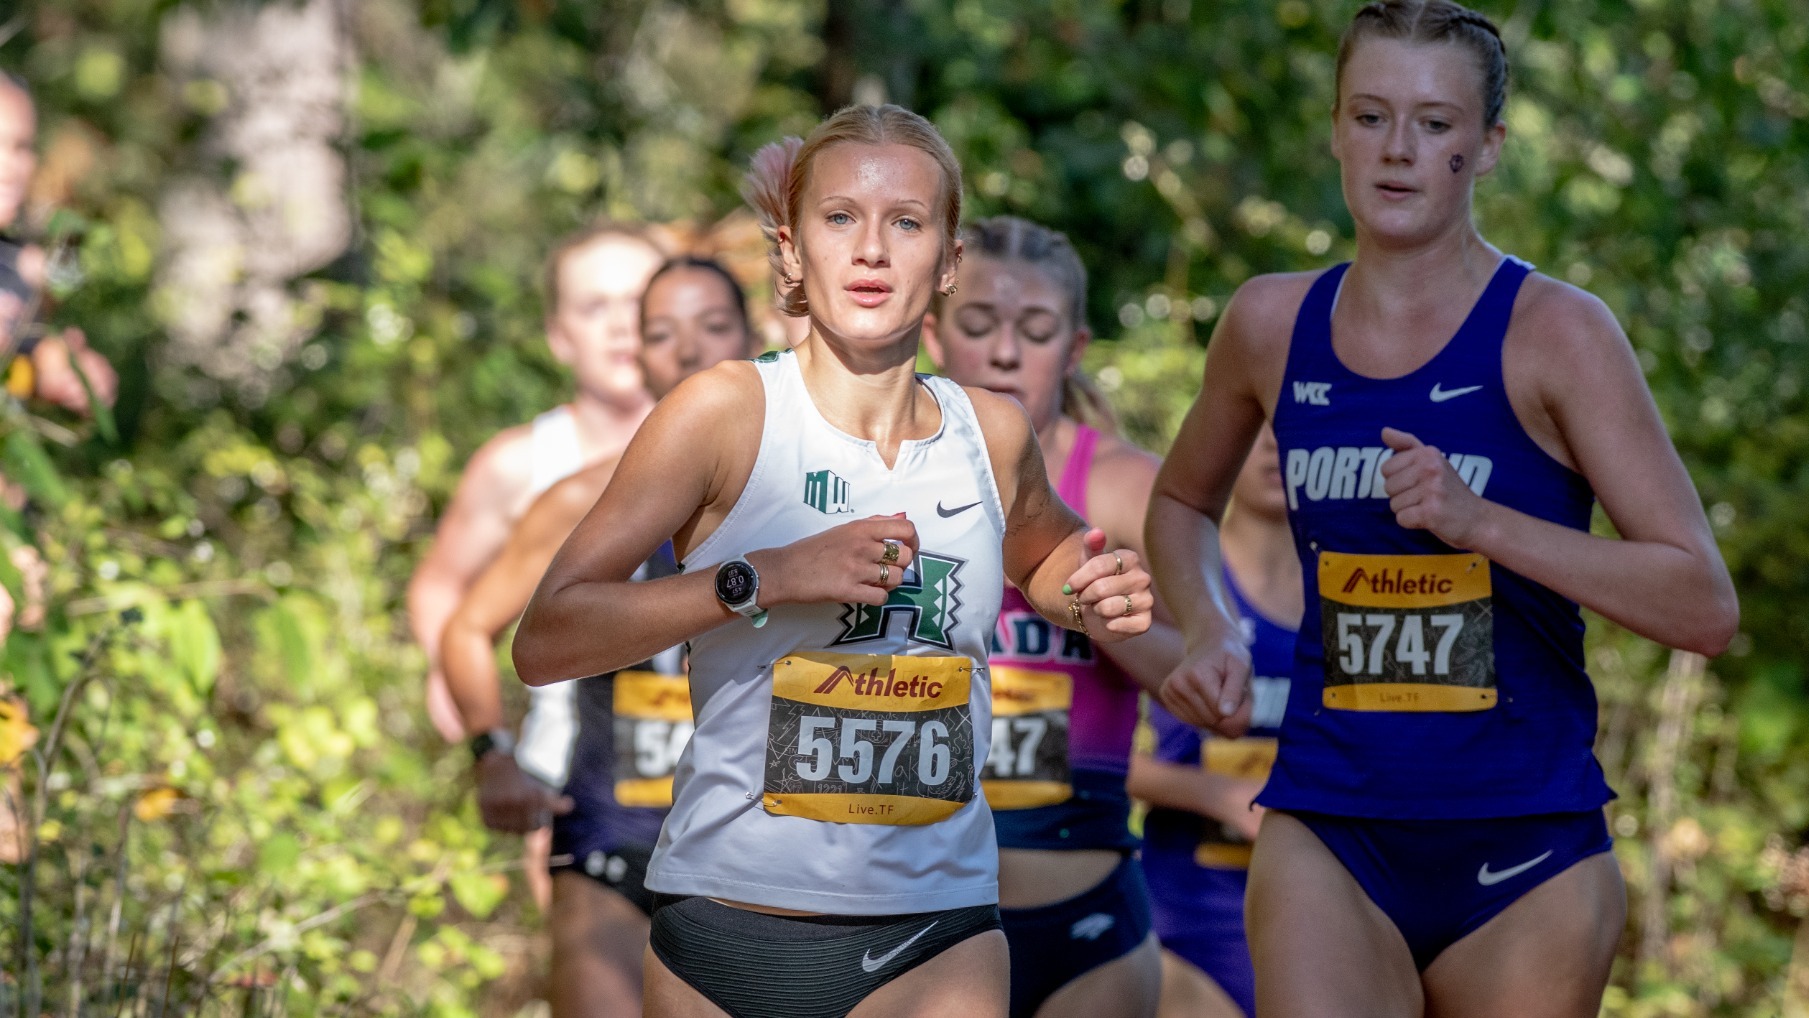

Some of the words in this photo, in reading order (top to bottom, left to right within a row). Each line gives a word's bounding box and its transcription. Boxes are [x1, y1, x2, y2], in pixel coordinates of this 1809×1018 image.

[1292, 381, 1333, 406] WCC
[1285, 446, 1494, 512] PORTLD
[1342, 567, 1453, 594] Athletic
[1336, 612, 1465, 675] 5747
[813, 665, 943, 699] Athletic
[796, 715, 951, 786] 5576
[848, 803, 895, 816] Live.TF
